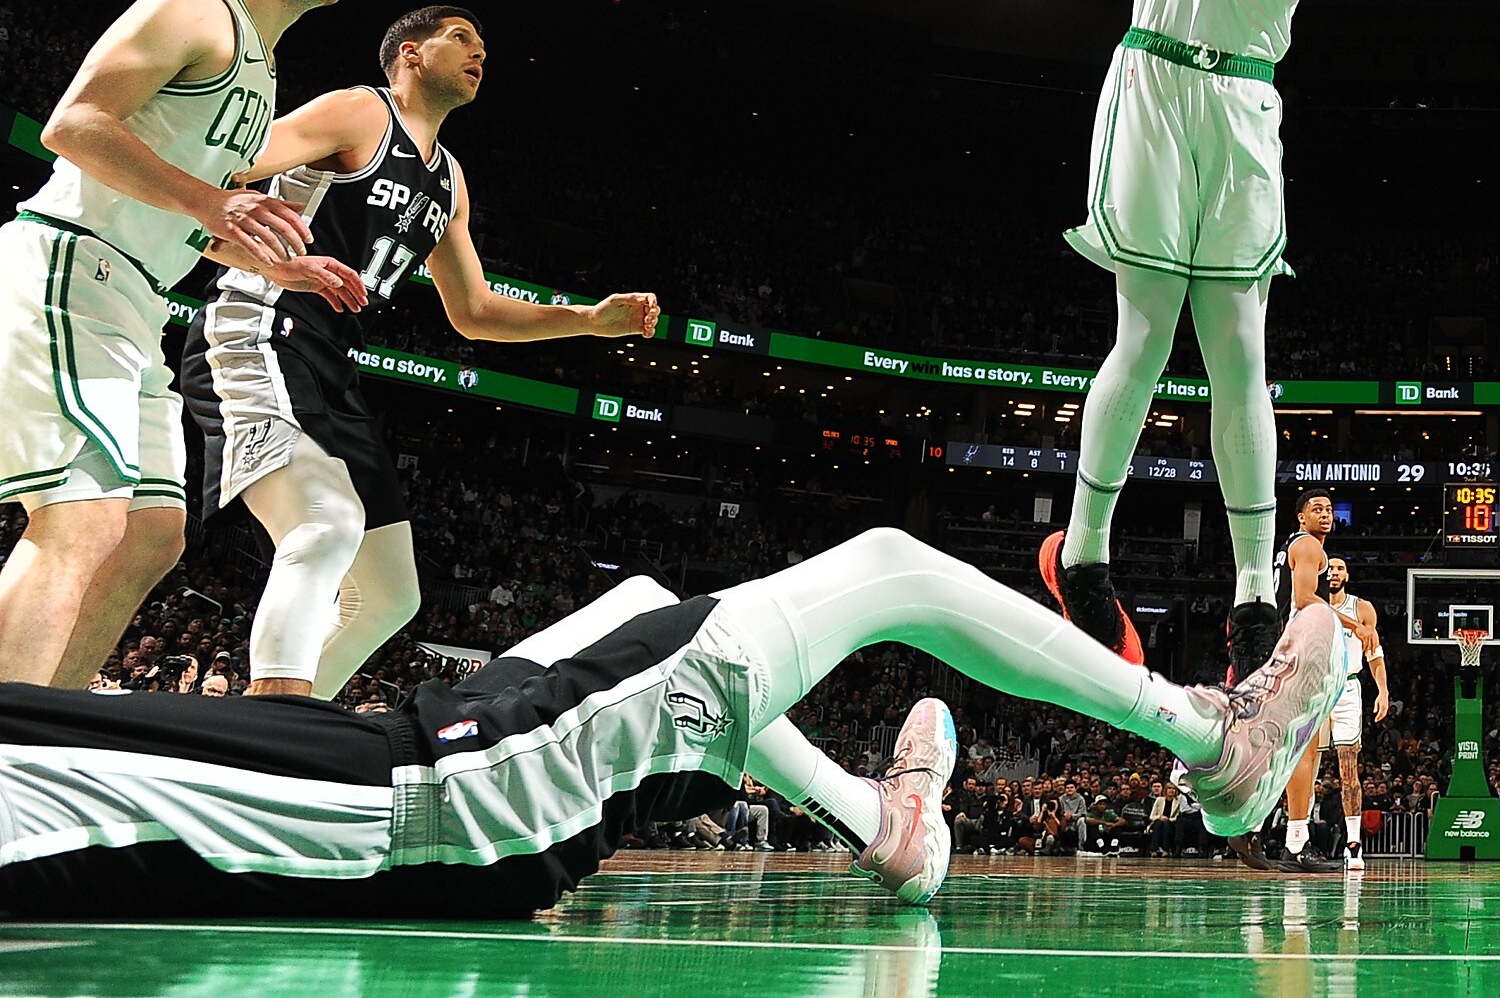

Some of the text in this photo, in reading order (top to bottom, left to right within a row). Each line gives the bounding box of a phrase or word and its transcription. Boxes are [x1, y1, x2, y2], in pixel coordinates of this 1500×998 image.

[360, 235, 416, 300] 17
[493, 281, 540, 304] story.
[690, 325, 755, 347] TD Bank
[382, 358, 396, 372] a
[397, 359, 447, 383] story.
[864, 351, 909, 373] Every
[912, 360, 940, 375] win
[942, 362, 973, 378] has
[974, 368, 986, 380] a
[987, 368, 1034, 384] story.
[1042, 371, 1088, 390] Every
[1167, 381, 1196, 396] has
[1197, 387, 1209, 397] a
[1398, 386, 1460, 402] TD Bank
[597, 400, 662, 423] TD Bank
[929, 447, 943, 458] 10
[1002, 456, 1202, 479] 14 8 12/28 43
[1295, 464, 1322, 481] SAN
[1325, 464, 1381, 481] ANTONIO
[1397, 464, 1425, 482] 29
[1456, 488, 1495, 504] 10:35
[1465, 504, 1490, 531] 10
[1460, 535, 1498, 543] TISSOT
[1458, 741, 1478, 751] VISTA
[1458, 751, 1478, 760] PRINT
[1445, 829, 1490, 838] new balance
